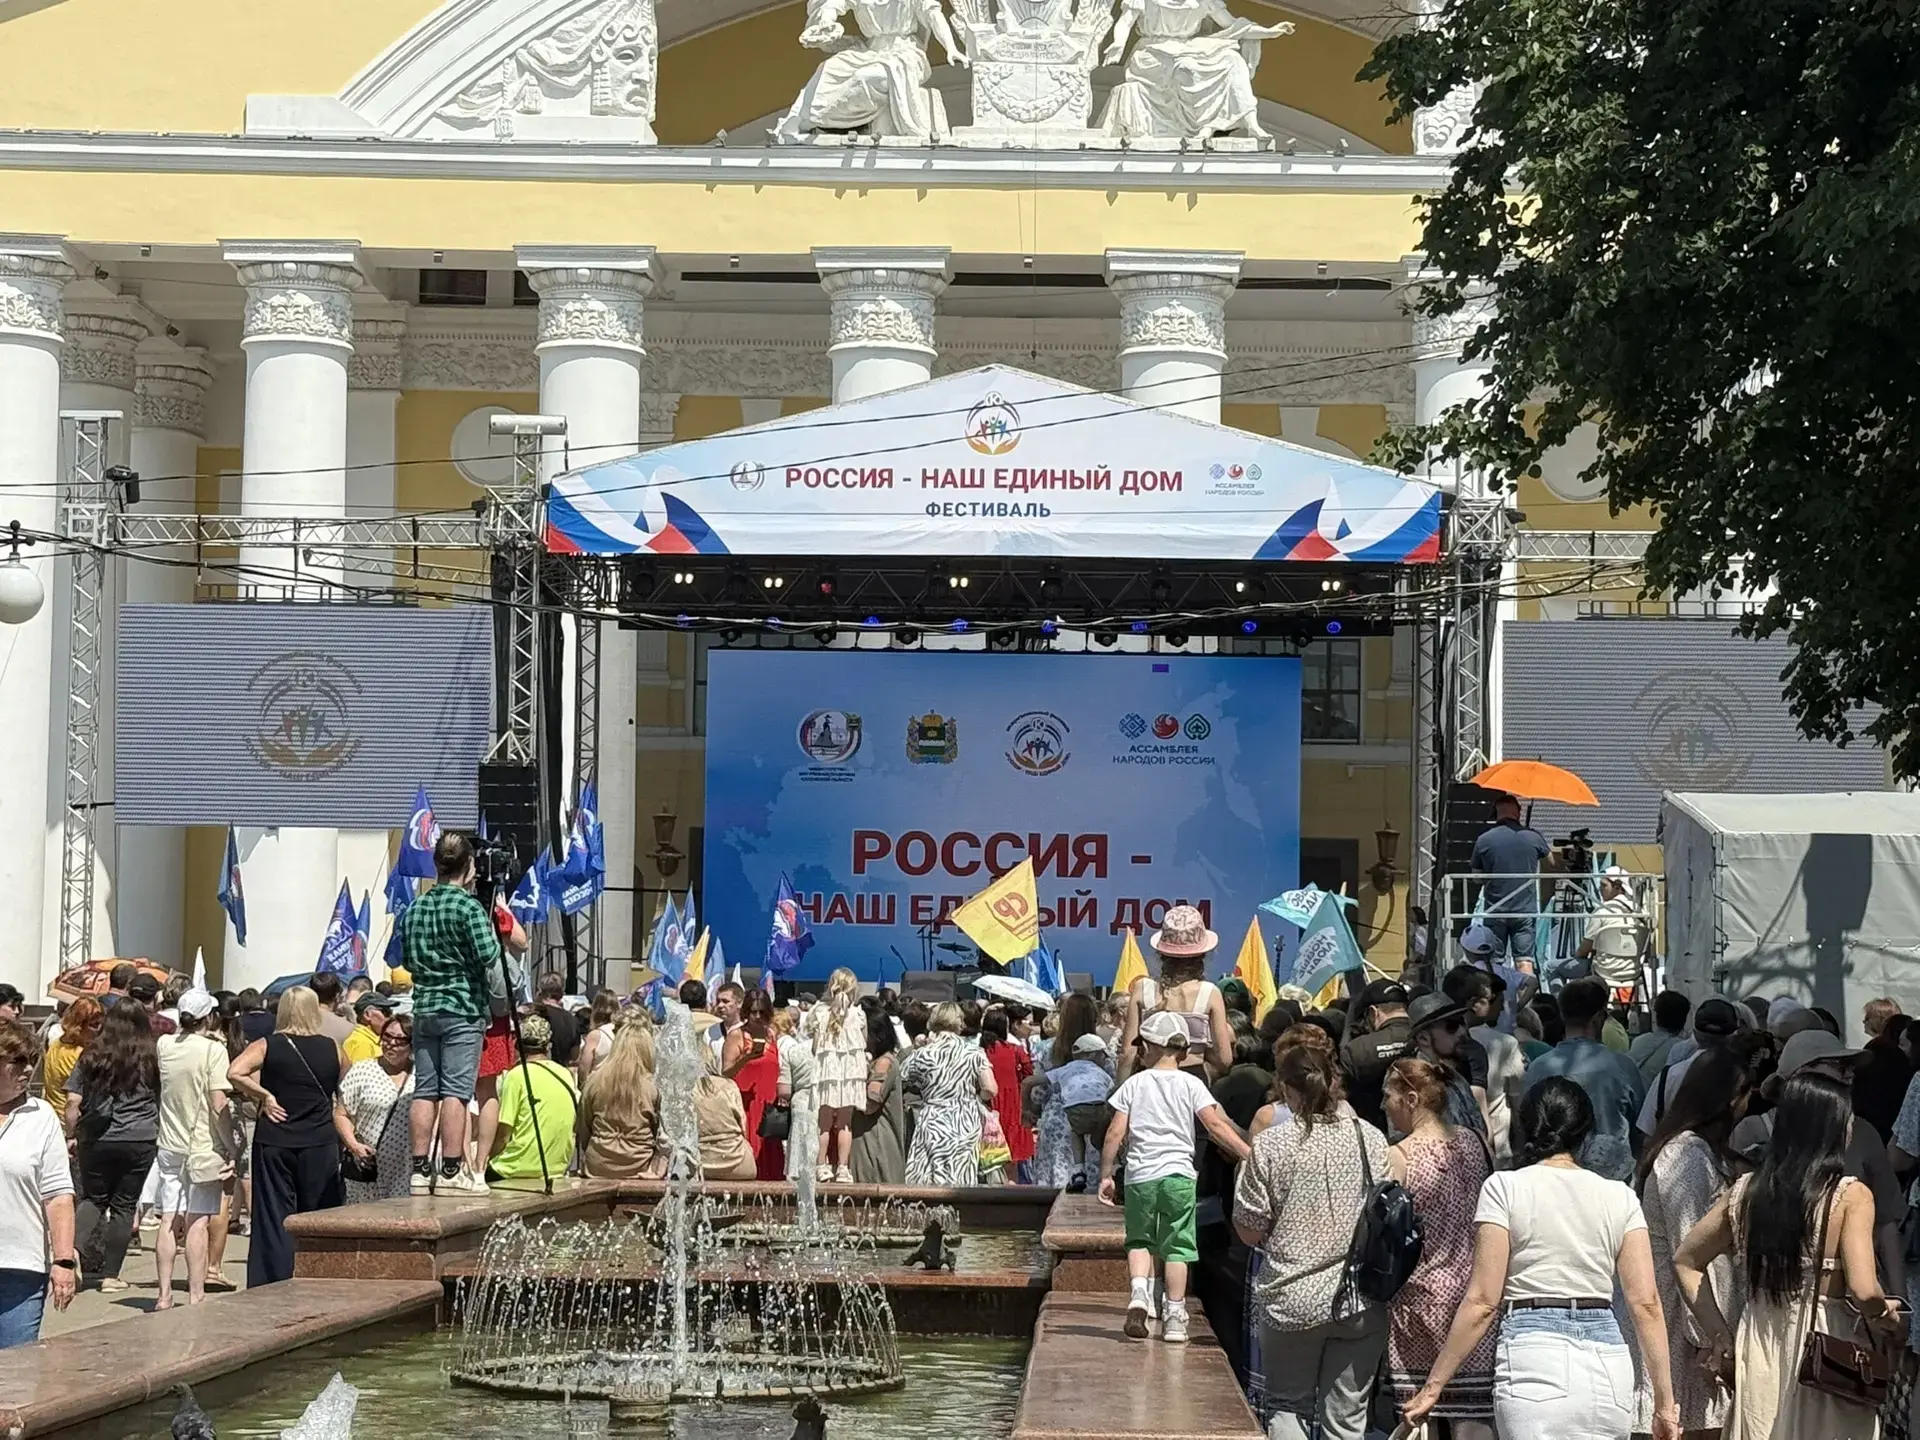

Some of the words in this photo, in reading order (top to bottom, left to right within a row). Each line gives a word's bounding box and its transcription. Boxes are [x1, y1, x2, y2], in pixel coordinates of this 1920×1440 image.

[785, 467, 893, 488] РОССИЯ
[921, 468, 985, 489] НАШ
[994, 464, 1111, 494] ЕДИНЫЙ
[1119, 470, 1183, 496] ДОМ
[925, 502, 1051, 517] ФЕСТИВАЛЬ
[1129, 745, 1199, 754] АССАМБЛЕЯ
[1112, 755, 1166, 766] НАРОДОВ
[1168, 756, 1216, 765] РОССИИ
[853, 830, 1109, 878] РОССИЯ
[1131, 855, 1152, 864] -
